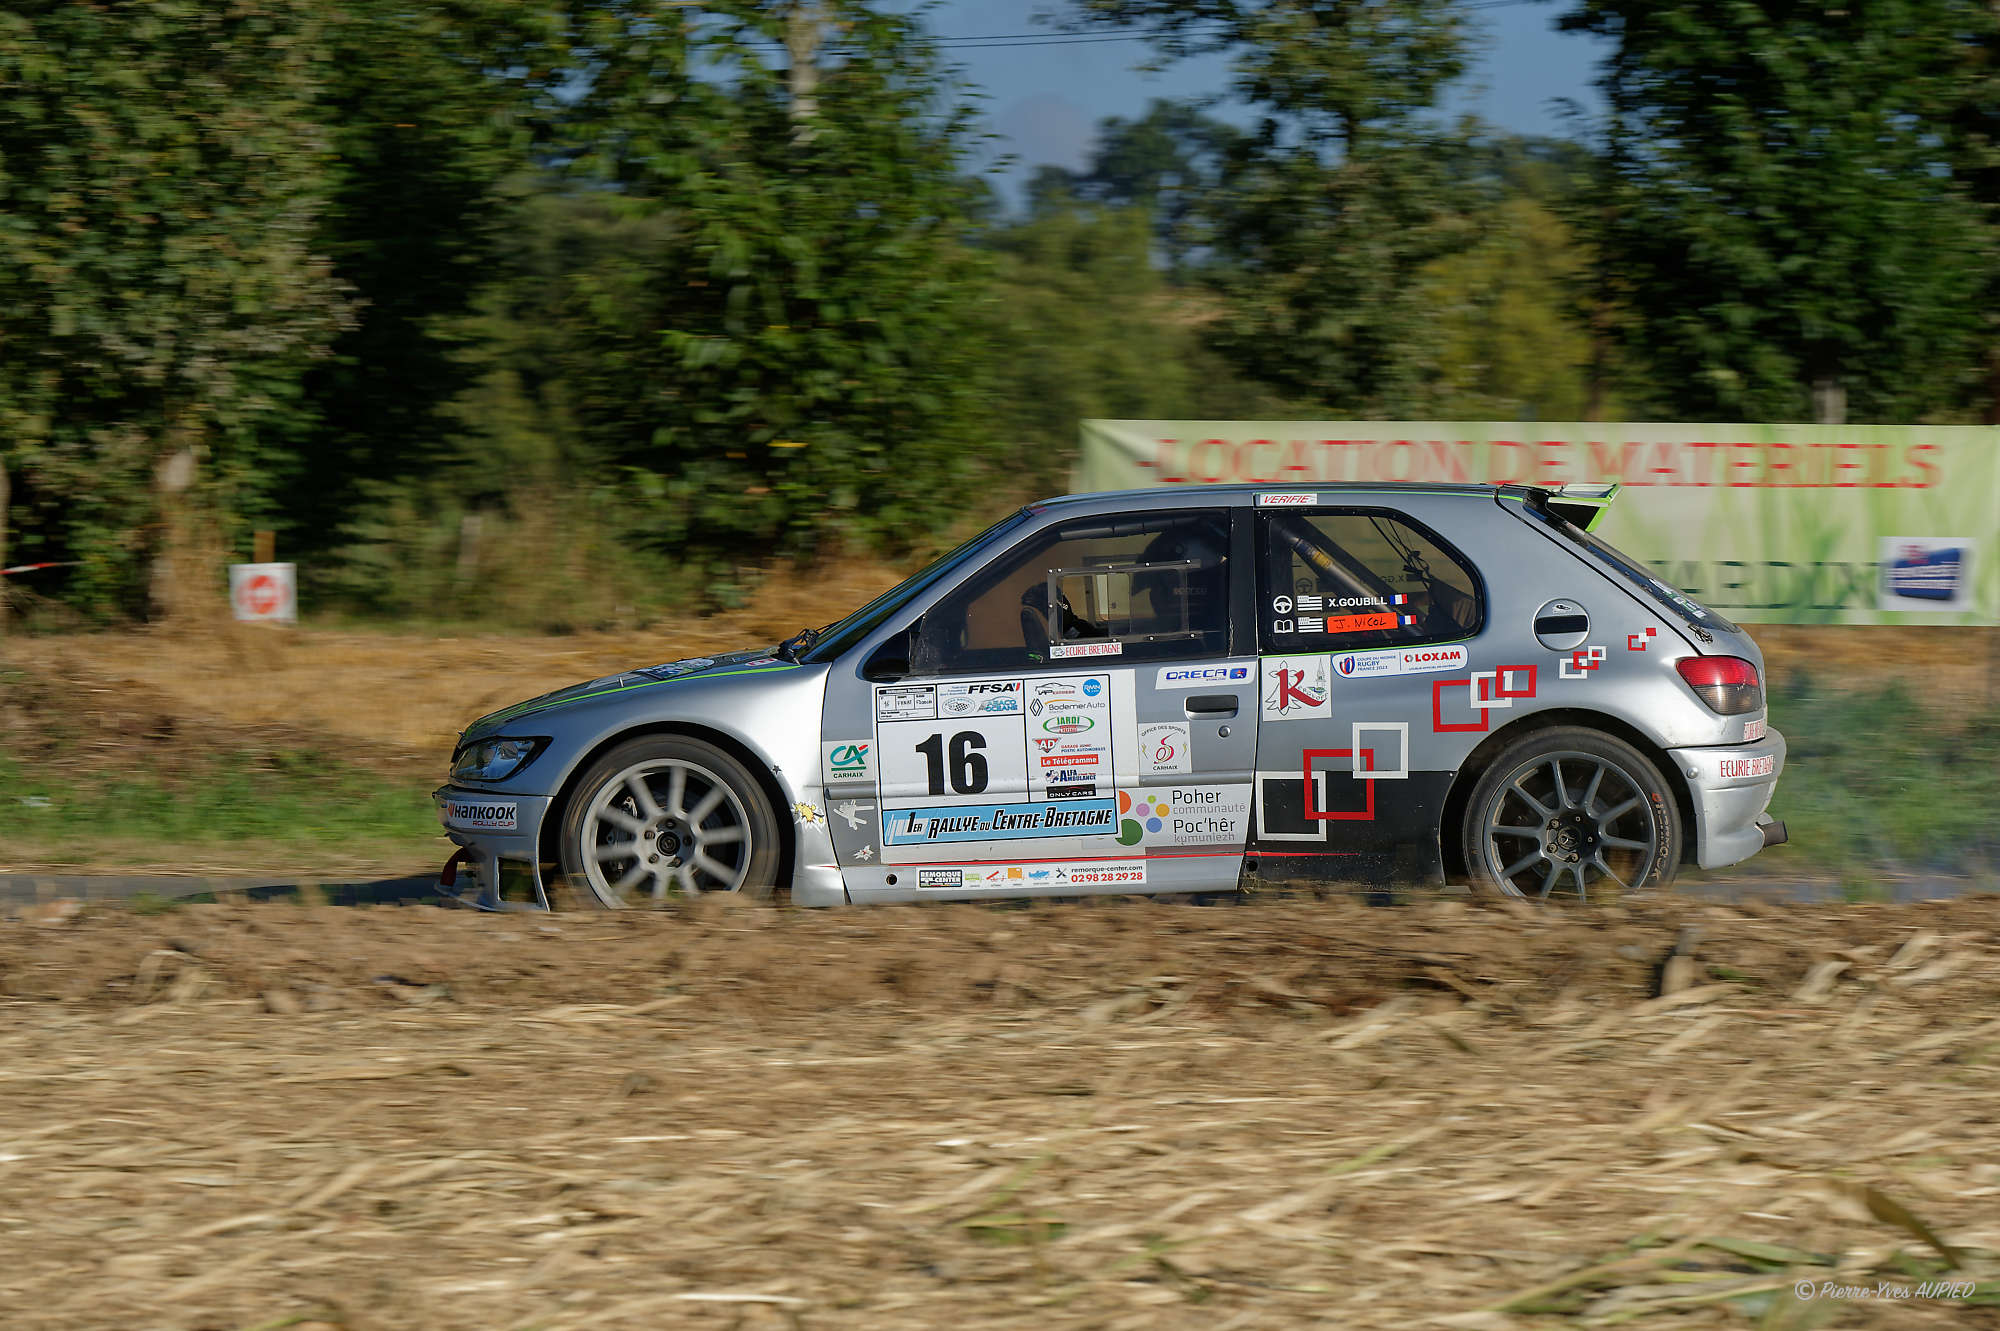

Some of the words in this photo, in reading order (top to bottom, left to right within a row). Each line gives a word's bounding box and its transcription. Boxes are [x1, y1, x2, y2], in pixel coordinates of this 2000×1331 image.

[1156, 438, 1478, 484] LOCATION
[1491, 440, 1571, 485] DE
[1264, 495, 1310, 504] VERIFIE
[1328, 597, 1388, 608] X.GOUBILL
[1354, 618, 1387, 628] NICOL
[1065, 644, 1088, 656] ECURIE
[1088, 642, 1121, 655] BRETAGNE
[1415, 651, 1461, 662] LOXAM
[1166, 669, 1227, 680] ORECA
[967, 683, 1015, 694] FFSA
[1040, 740, 1055, 749] AD
[915, 730, 989, 797] 16
[1053, 757, 1097, 766] Télégramme
[1720, 758, 1750, 778] ECURIE
[1172, 789, 1222, 805] Poher
[1173, 803, 1246, 815] communauté
[906, 811, 923, 834] 1ER
[928, 815, 980, 839] RALLYE
[979, 821, 991, 832] DU
[991, 807, 1114, 831] CENTRE-BRETAGNE
[1173, 817, 1236, 834] Poc'hêr
[1071, 865, 1143, 875] remorque-center.com
[1071, 874, 1085, 883] 02
[1086, 873, 1099, 883] 98
[1100, 873, 1114, 882] 28
[1115, 872, 1128, 881] 29
[1129, 871, 1143, 881] 28
